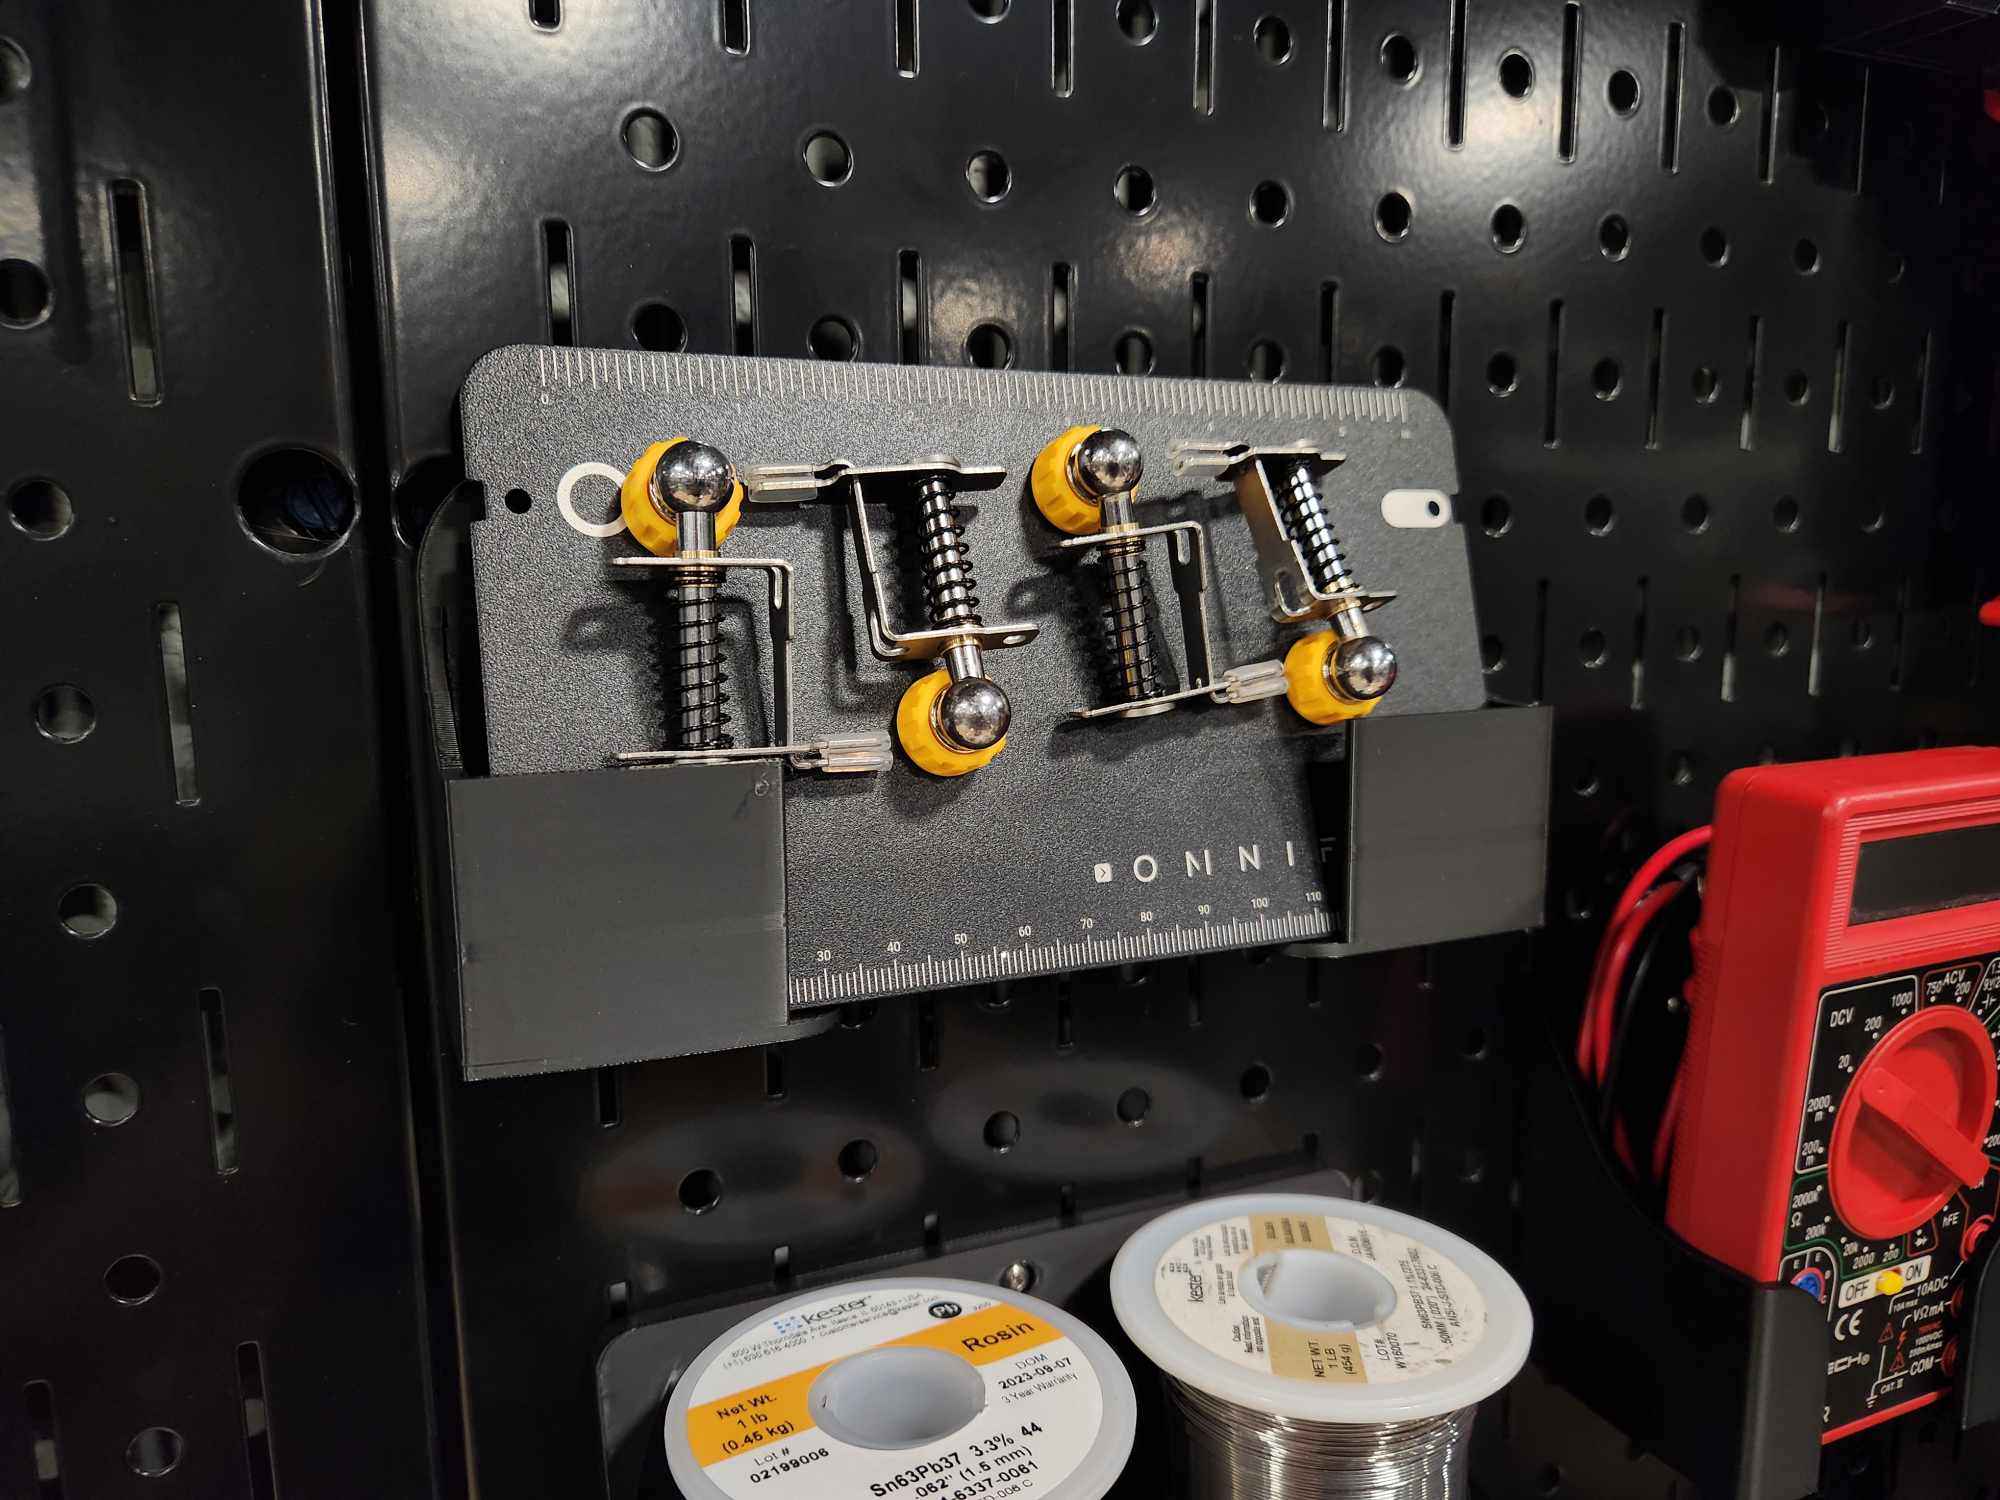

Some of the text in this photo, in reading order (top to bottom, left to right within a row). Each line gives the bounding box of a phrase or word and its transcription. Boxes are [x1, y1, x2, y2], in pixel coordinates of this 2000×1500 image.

[816, 891, 1322, 962] 30 40 50 60 70 80 90 100 110
[1926, 979, 1971, 996] 750 200
[1943, 969, 1966, 986] ACV
[1891, 991, 1913, 1008] 1000
[1829, 1007, 1854, 1028] DCV
[1864, 1015, 1882, 1032] 200
[1838, 1054, 1850, 1070] 20
[1807, 1094, 1830, 1112] 2000
[1814, 1111, 1822, 1121] m
[1802, 1140, 1819, 1155] 200
[1805, 1156, 1814, 1166] m
[1845, 1263, 1923, 1301] OFF ON
[1916, 1276, 1949, 1297] 10ADC
[803, 1296, 869, 1325] kester
[961, 1322, 1035, 1352] Rosin
[1325, 1348, 1337, 1360] LB
[1339, 1343, 1358, 1375] (454 g)
[1386, 1331, 1407, 1369] W160070
[1015, 1353, 1048, 1370] DOM
[1312, 1359, 1326, 1378] NET
[1910, 1356, 1934, 1376] COM
[1002, 1372, 1078, 1404] 3 Year Warranty
[716, 1394, 777, 1419] Net Wt.
[737, 1412, 768, 1428] 1 lb
[722, 1420, 795, 1454] (0.45 kg)
[750, 1448, 830, 1484] 02199006
[755, 1447, 789, 1466] Lot #
[870, 1422, 1043, 1497] Sn63Pb37 3.3% 44
[993, 1446, 1033, 1467] mm)
